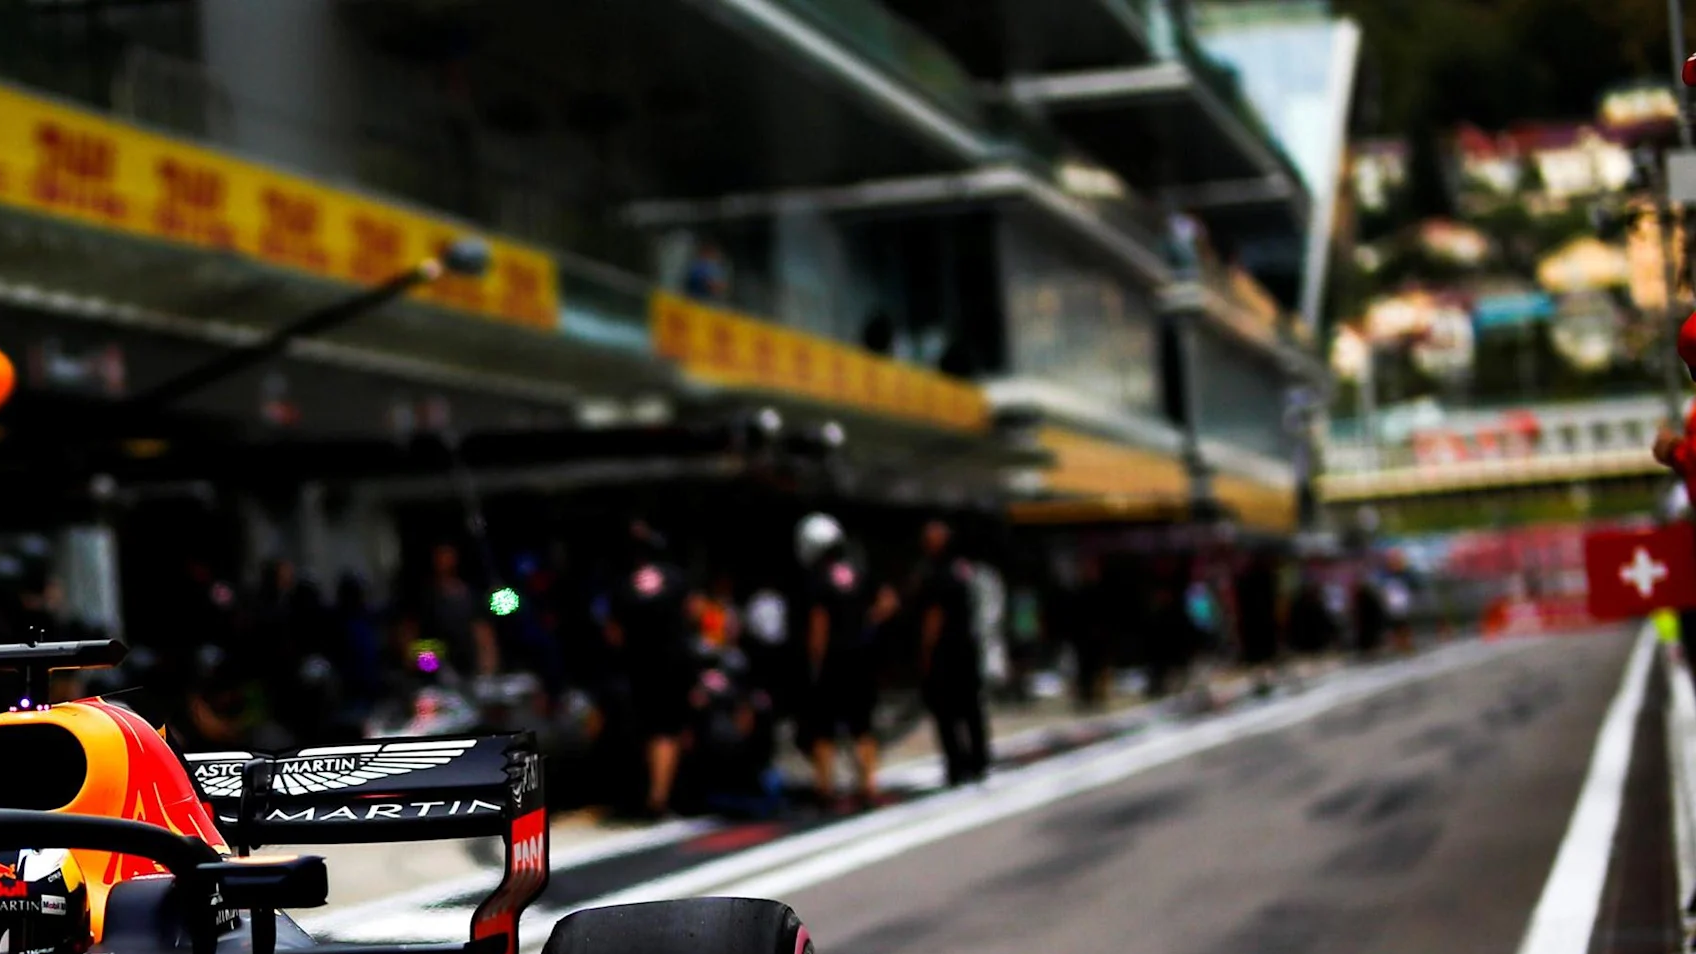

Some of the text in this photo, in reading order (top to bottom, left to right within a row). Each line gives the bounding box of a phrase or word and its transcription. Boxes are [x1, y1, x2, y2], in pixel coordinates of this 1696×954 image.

[194, 757, 356, 778] ASTO MARTIN
[266, 800, 503, 821] MARTIN
